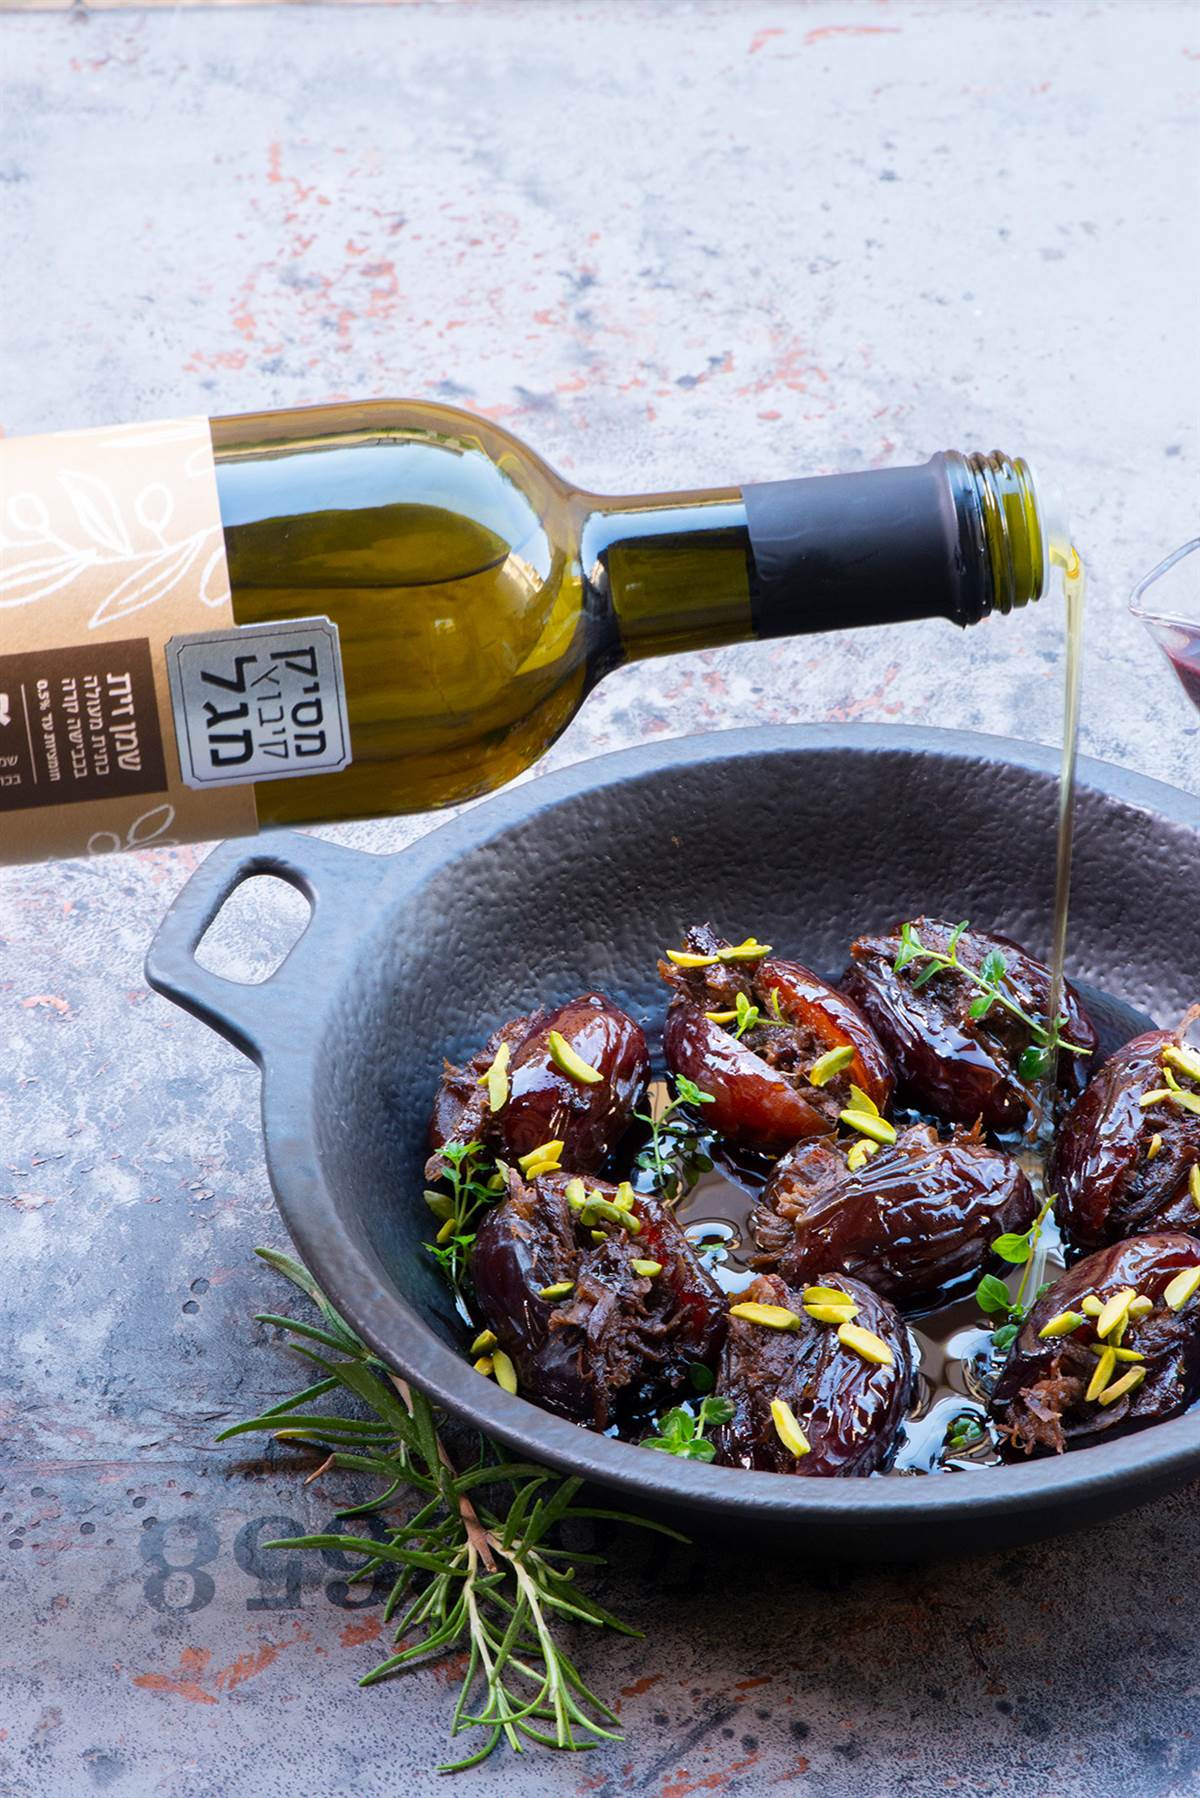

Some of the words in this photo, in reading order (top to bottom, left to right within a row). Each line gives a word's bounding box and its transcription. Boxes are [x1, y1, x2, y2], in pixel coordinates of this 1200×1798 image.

[36, 679, 51, 711] 0.5%
[61, 677, 79, 714] קרה
[83, 675, 104, 731] מעולה
[106, 672, 135, 716] זית
[201, 655, 257, 767] מגל
[251, 665, 289, 759] קיבוץ
[270, 646, 326, 757] מסיק
[41, 712, 54, 731] עד
[109, 721, 142, 771] שמן
[44, 732, 61, 782] חומציות
[67, 717, 88, 779] בכבישה
[91, 735, 110, 775] כתית
